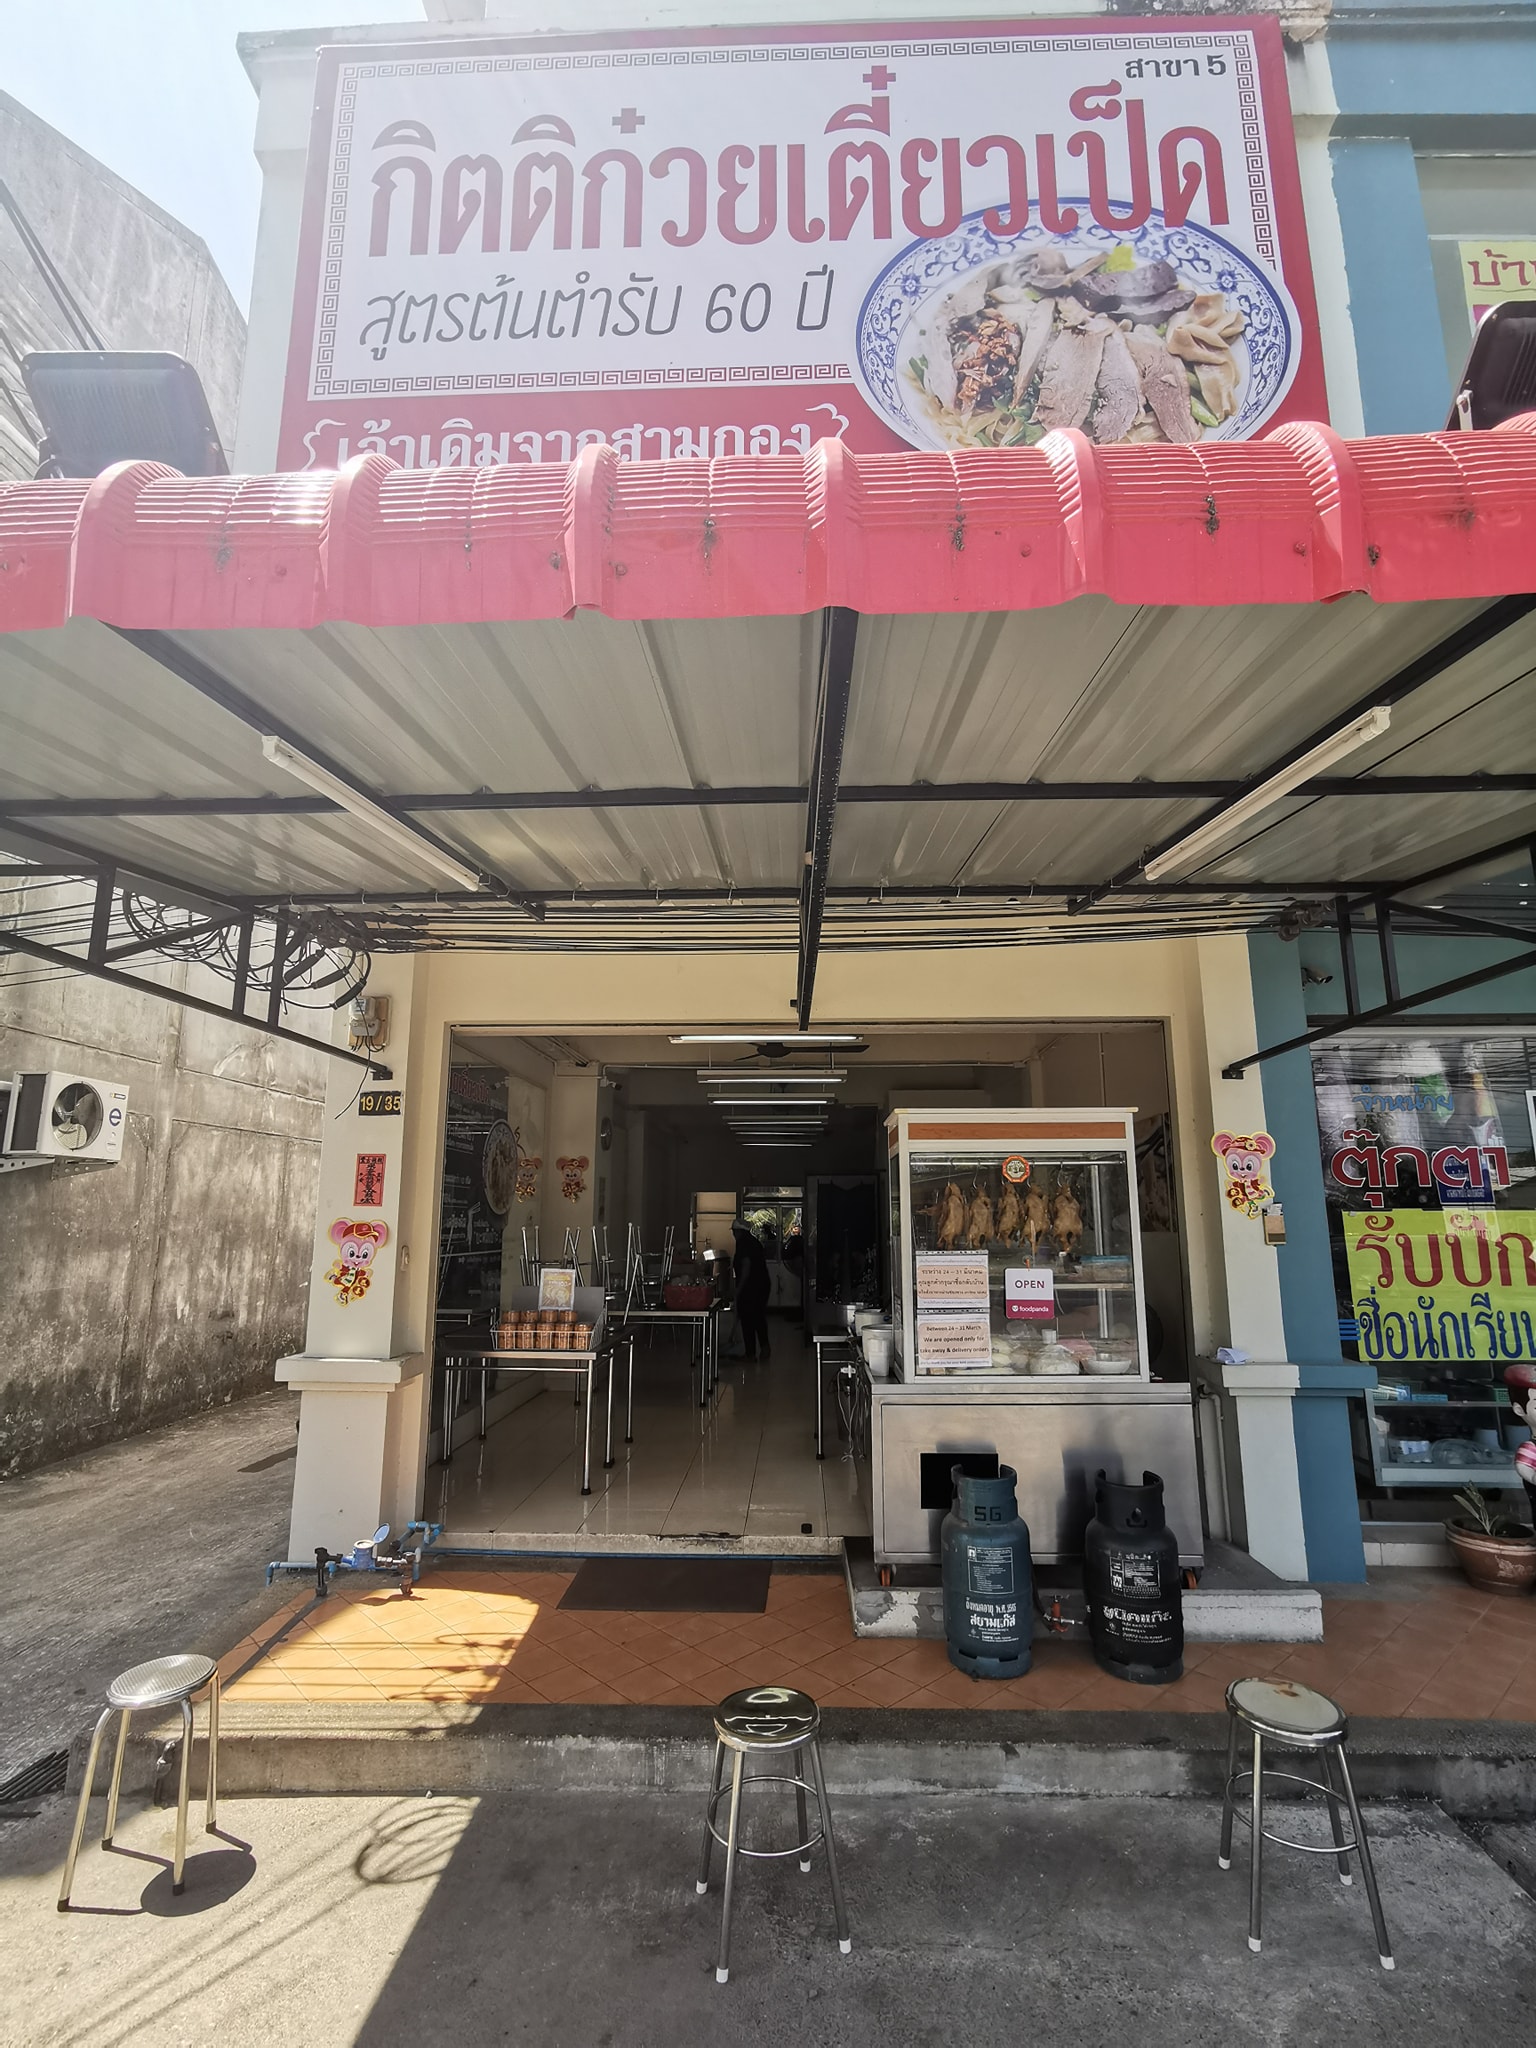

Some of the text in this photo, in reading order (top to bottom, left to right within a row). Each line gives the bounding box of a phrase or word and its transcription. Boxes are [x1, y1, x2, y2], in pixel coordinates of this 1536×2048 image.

[1125, 54, 1227, 79] สาขา 5
[368, 64, 1232, 258] กิตติก๋วยเตี๋ยวเป็ด
[359, 263, 836, 361] สูตรต้นตำรับ 60 ปี
[360, 1095, 401, 1111] 19/35
[1352, 1084, 1455, 1112] จำหน่าย
[1331, 1128, 1511, 1208] ตุ๊กตา
[1014, 1280, 1045, 1289] OPEN
[1019, 1305, 1049, 1313] foodpanda
[970, 1613, 1016, 1628] สยามแก๊ส
